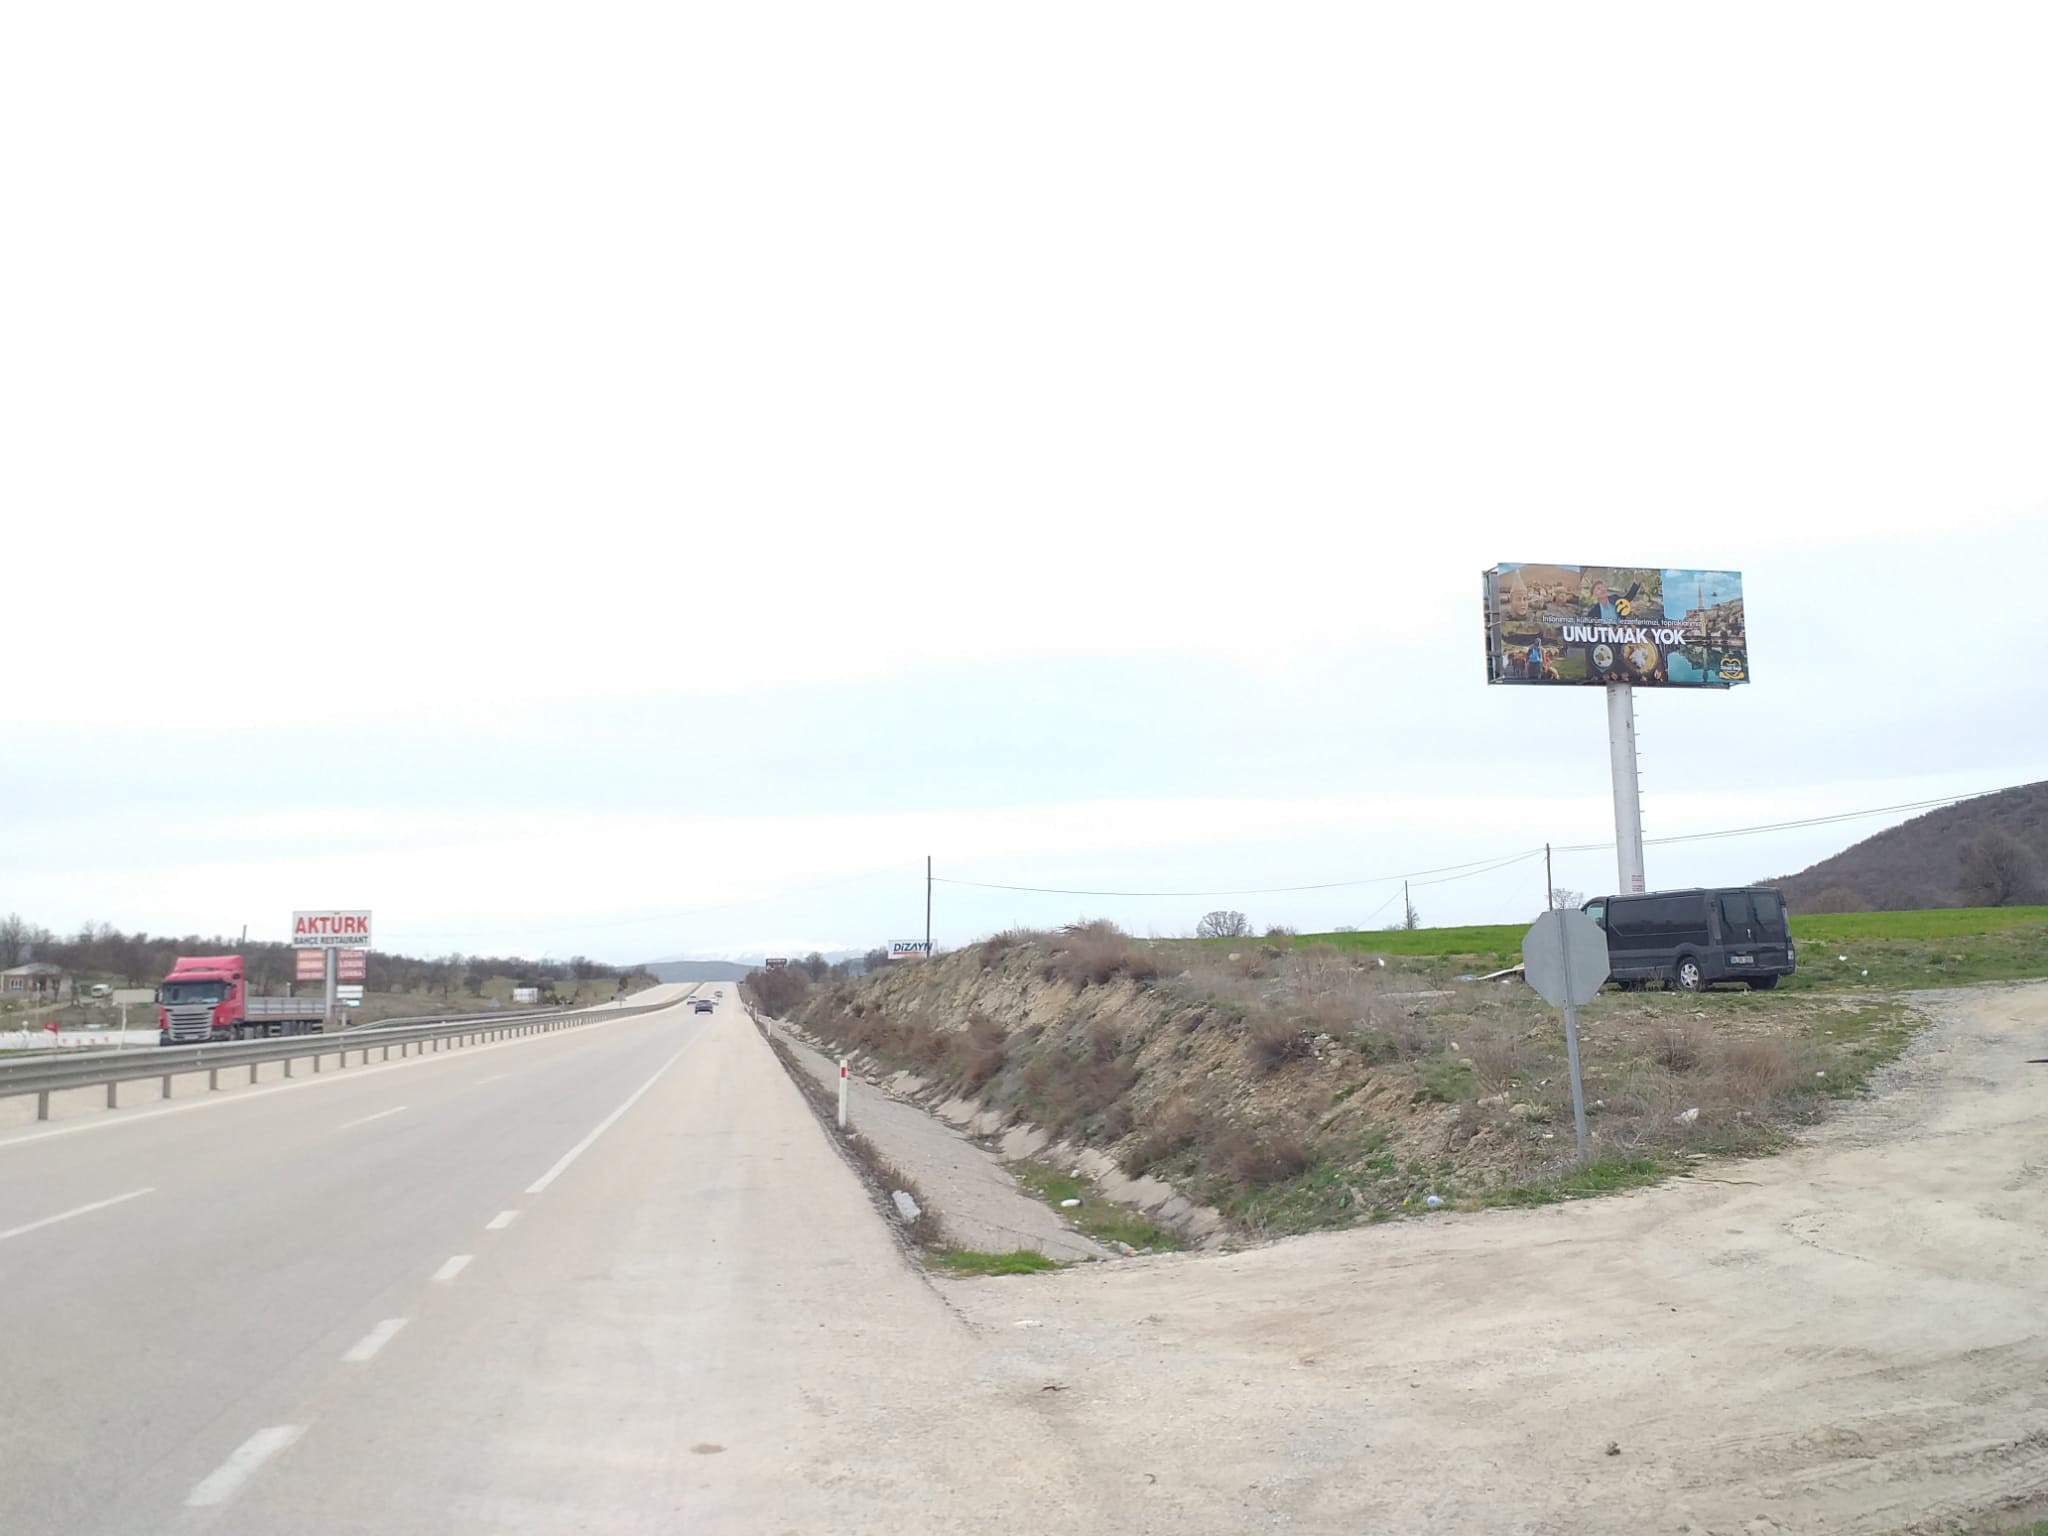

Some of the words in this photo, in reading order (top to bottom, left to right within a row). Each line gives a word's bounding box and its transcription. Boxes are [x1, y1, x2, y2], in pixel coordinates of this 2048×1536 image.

[1562, 625, 1648, 644] UNUTMAK
[1651, 628, 1686, 646] YOK
[295, 912, 368, 934] AKTÜRK
[321, 936, 368, 945] RESTAURANT
